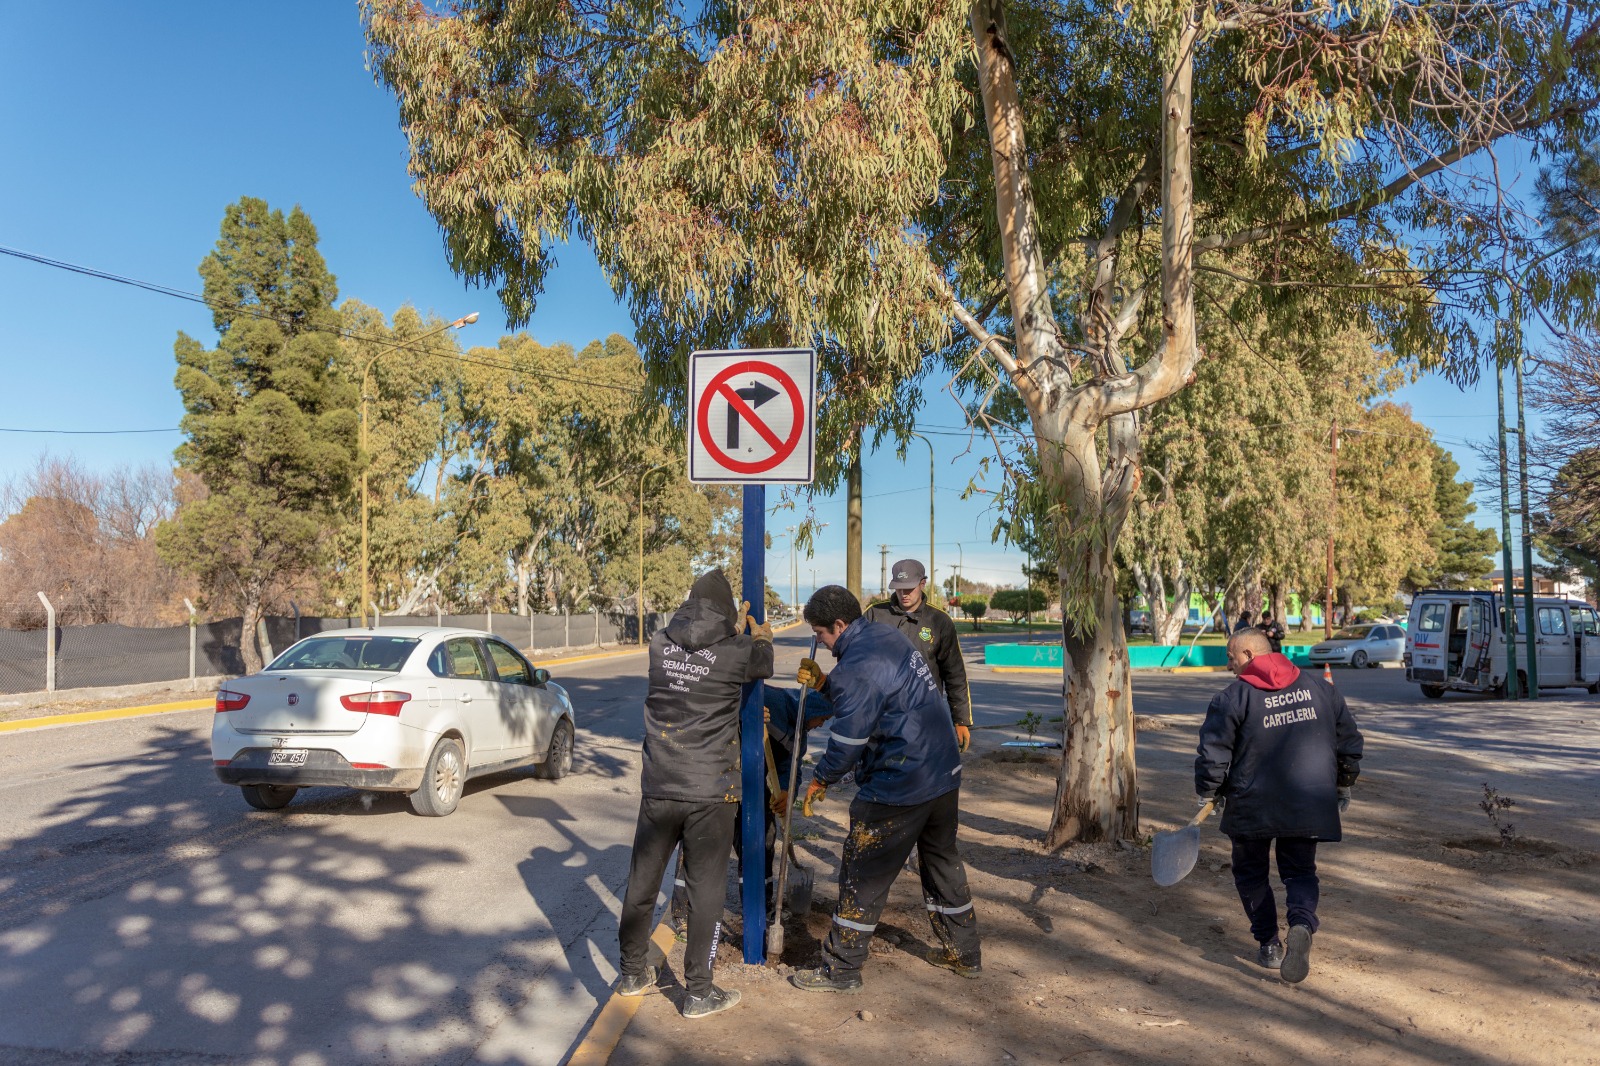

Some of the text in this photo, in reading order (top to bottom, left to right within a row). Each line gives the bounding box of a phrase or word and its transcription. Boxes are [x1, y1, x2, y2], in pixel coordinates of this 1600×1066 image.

[663, 644, 717, 665] CARERIA
[685, 653, 692, 662] Y
[662, 660, 710, 675] SEMAFORO
[666, 670, 701, 682] Municipalidad
[1264, 688, 1312, 709] SECCIÓN
[1263, 707, 1318, 728] CARTELERIA
